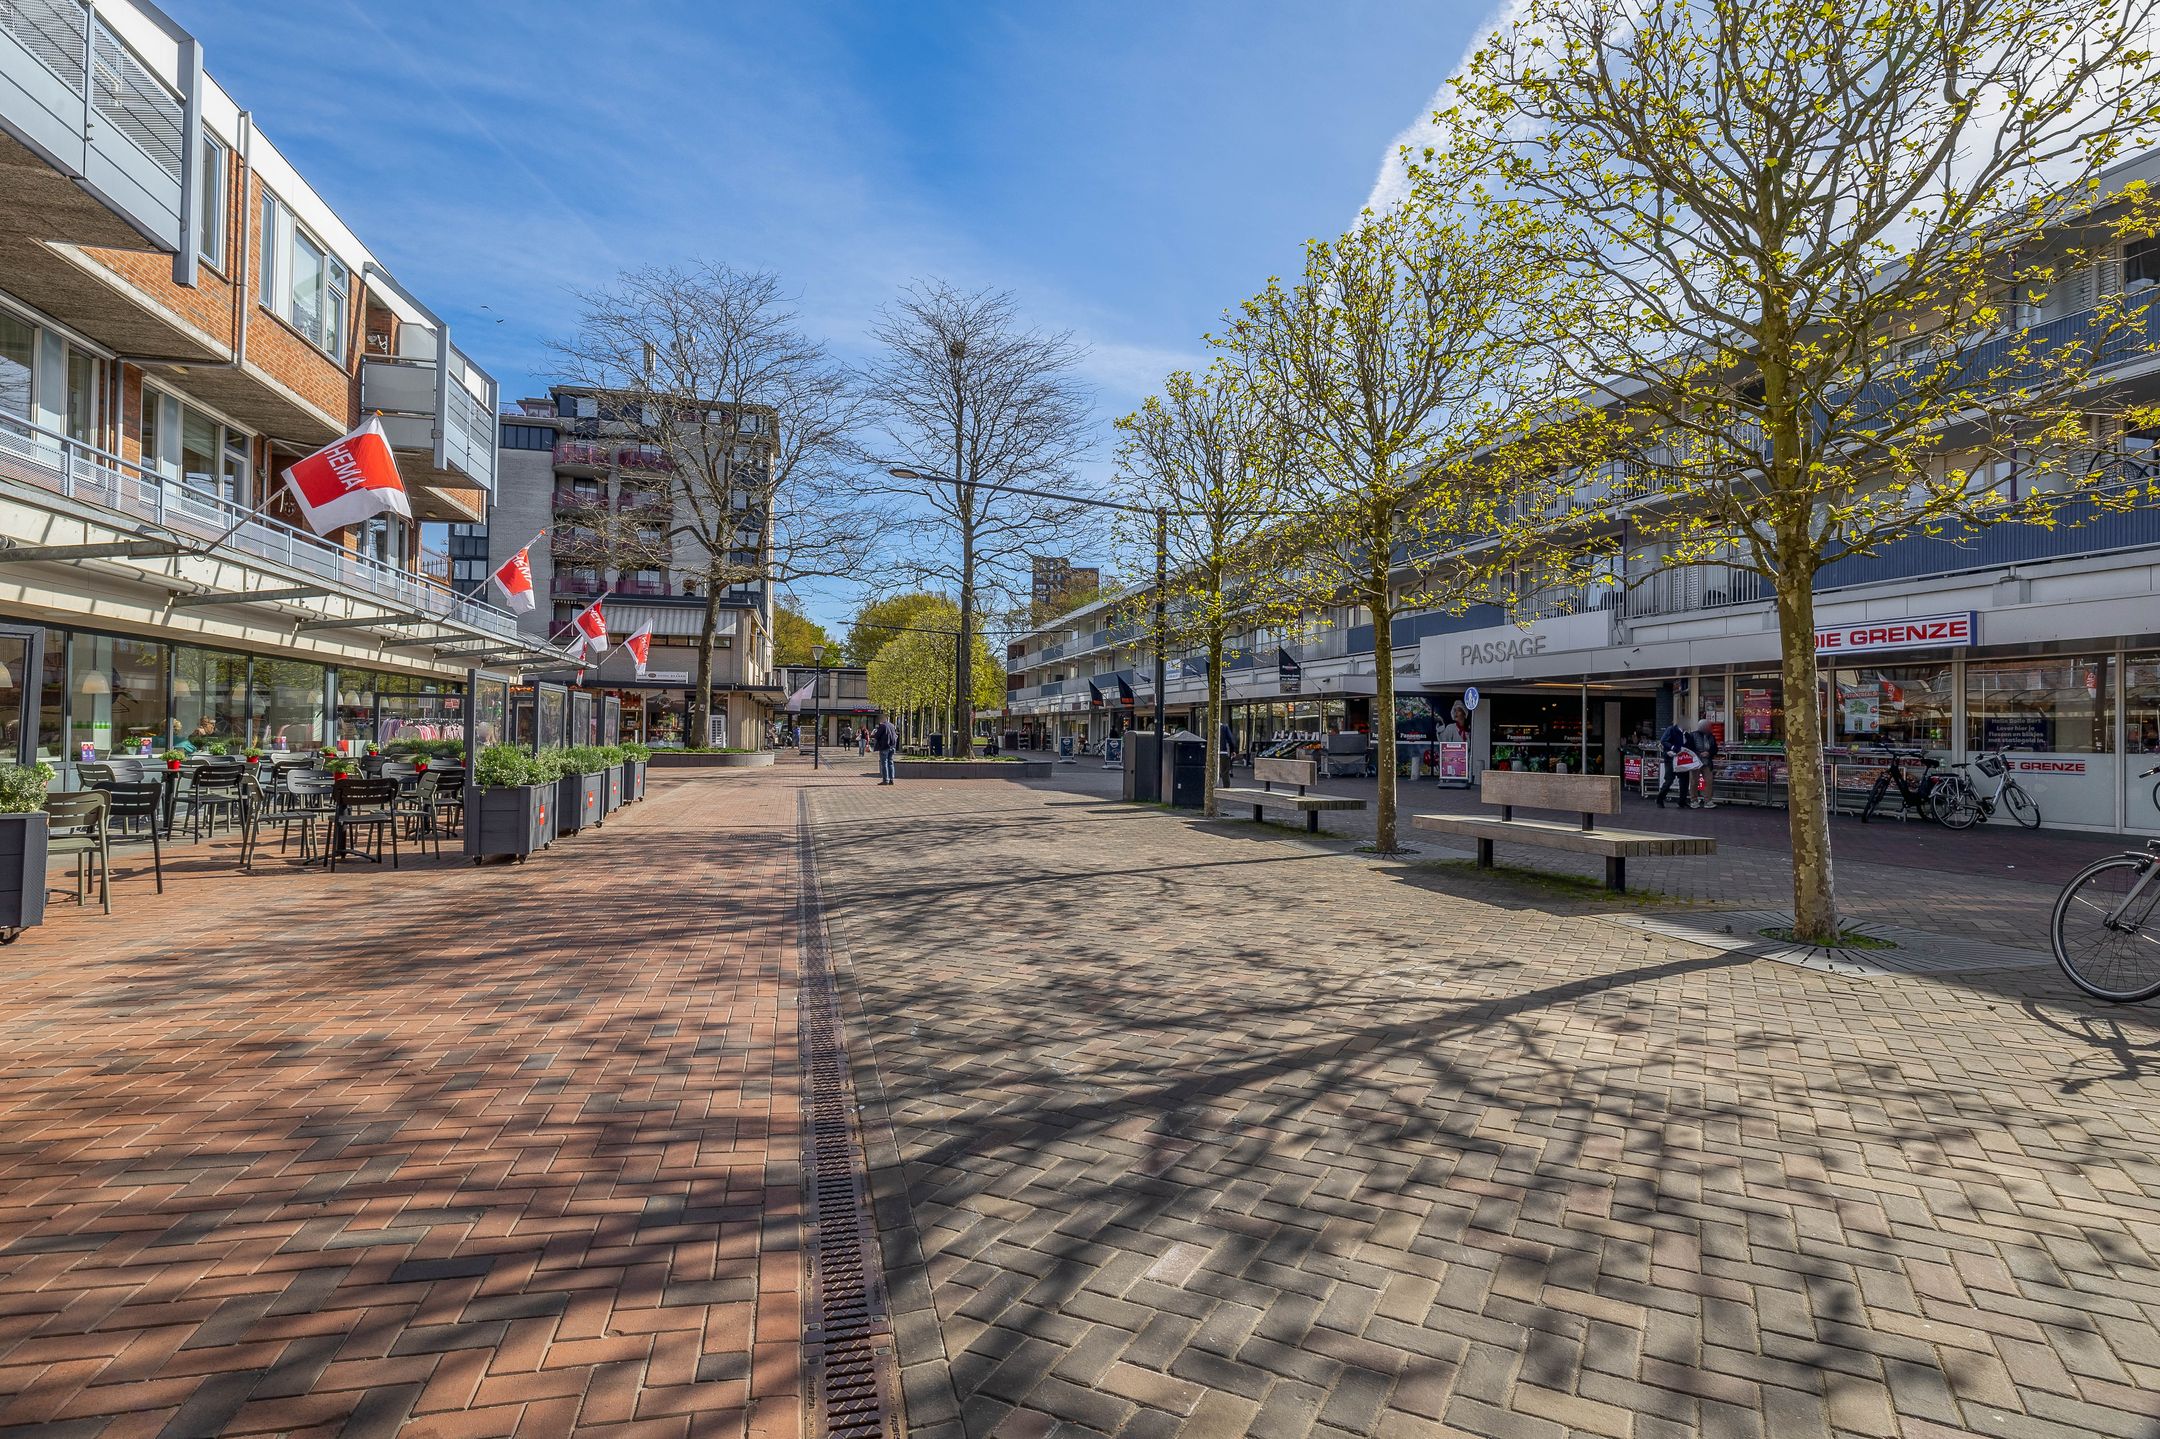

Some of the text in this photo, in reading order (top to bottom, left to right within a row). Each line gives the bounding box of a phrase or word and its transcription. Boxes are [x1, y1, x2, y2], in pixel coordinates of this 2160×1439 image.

[324, 444, 367, 491] HEMA
[1850, 621, 1968, 646] GRENZE
[1461, 635, 1546, 665] PASSAGE
[2020, 761, 2085, 772] GRENZE
